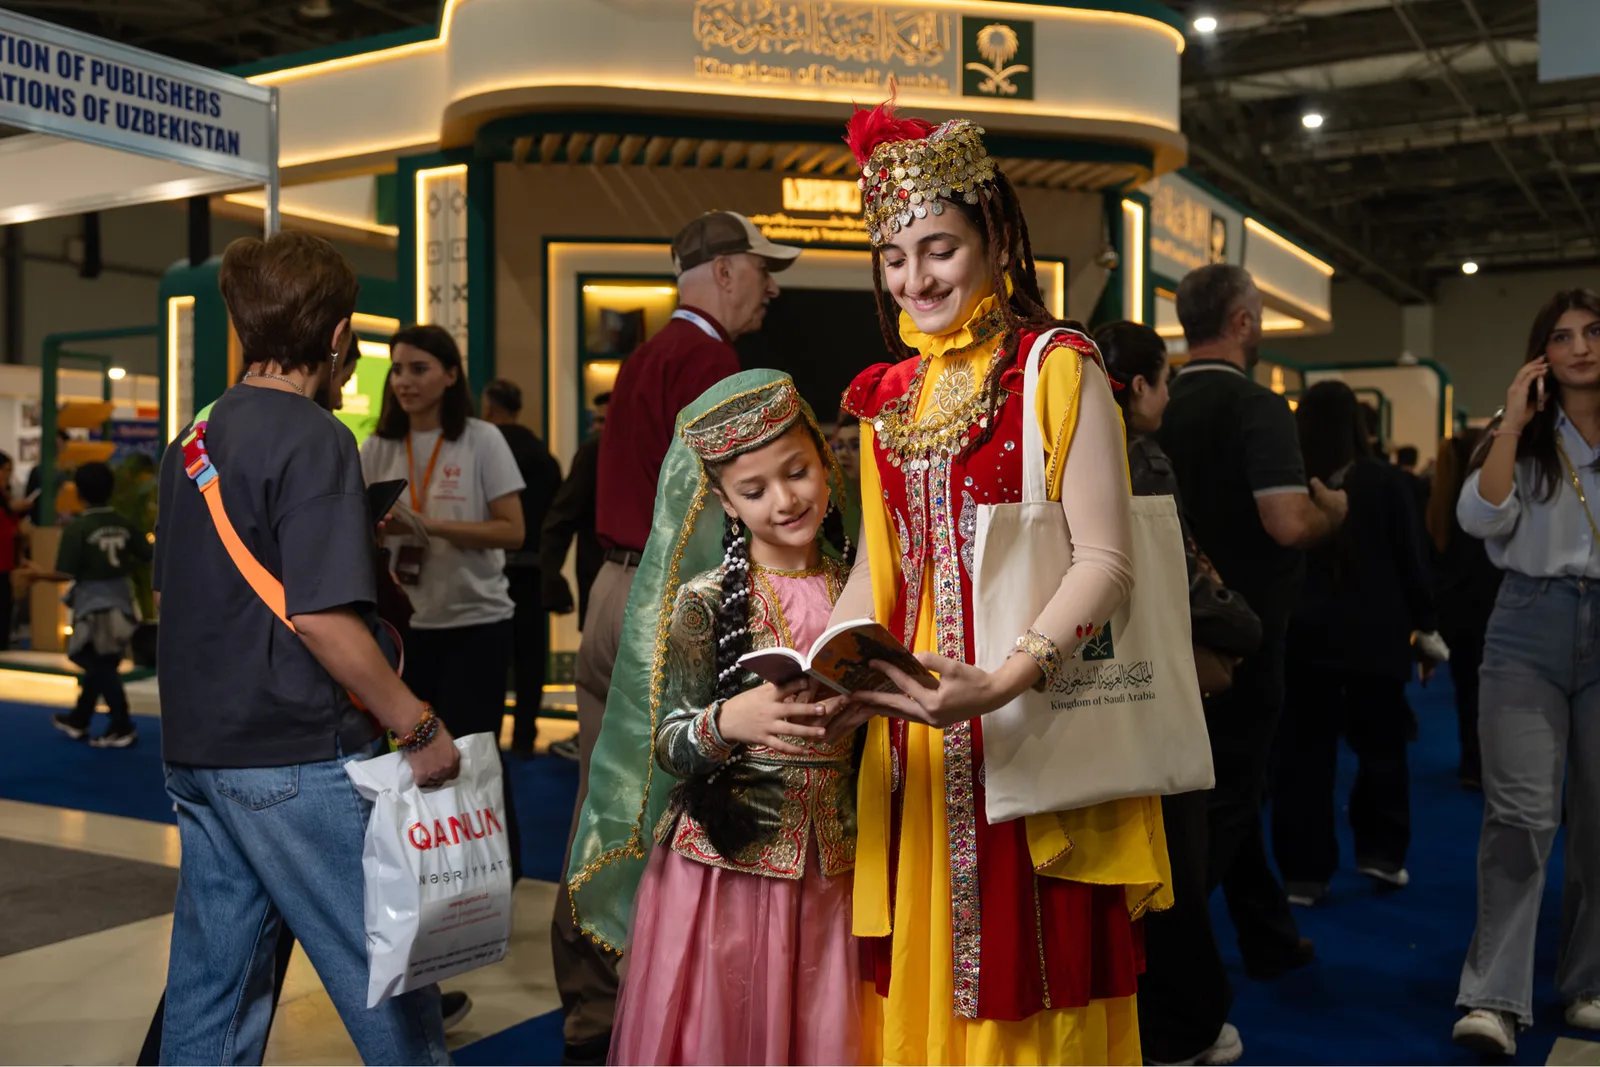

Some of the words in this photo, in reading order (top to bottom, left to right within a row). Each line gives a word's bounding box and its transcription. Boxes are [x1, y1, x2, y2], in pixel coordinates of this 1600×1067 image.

[57, 51, 85, 81] OF
[91, 61, 222, 118] PUBLISHERS
[0, 72, 76, 117] TIONS
[83, 95, 110, 125] OF
[116, 103, 240, 156] UZBEKISTAN
[1050, 697, 1091, 711] Kingdom
[1092, 696, 1102, 706] of
[1103, 693, 1126, 705] Saudi
[1126, 690, 1156, 703] Arabia
[408, 808, 502, 851] QANUN
